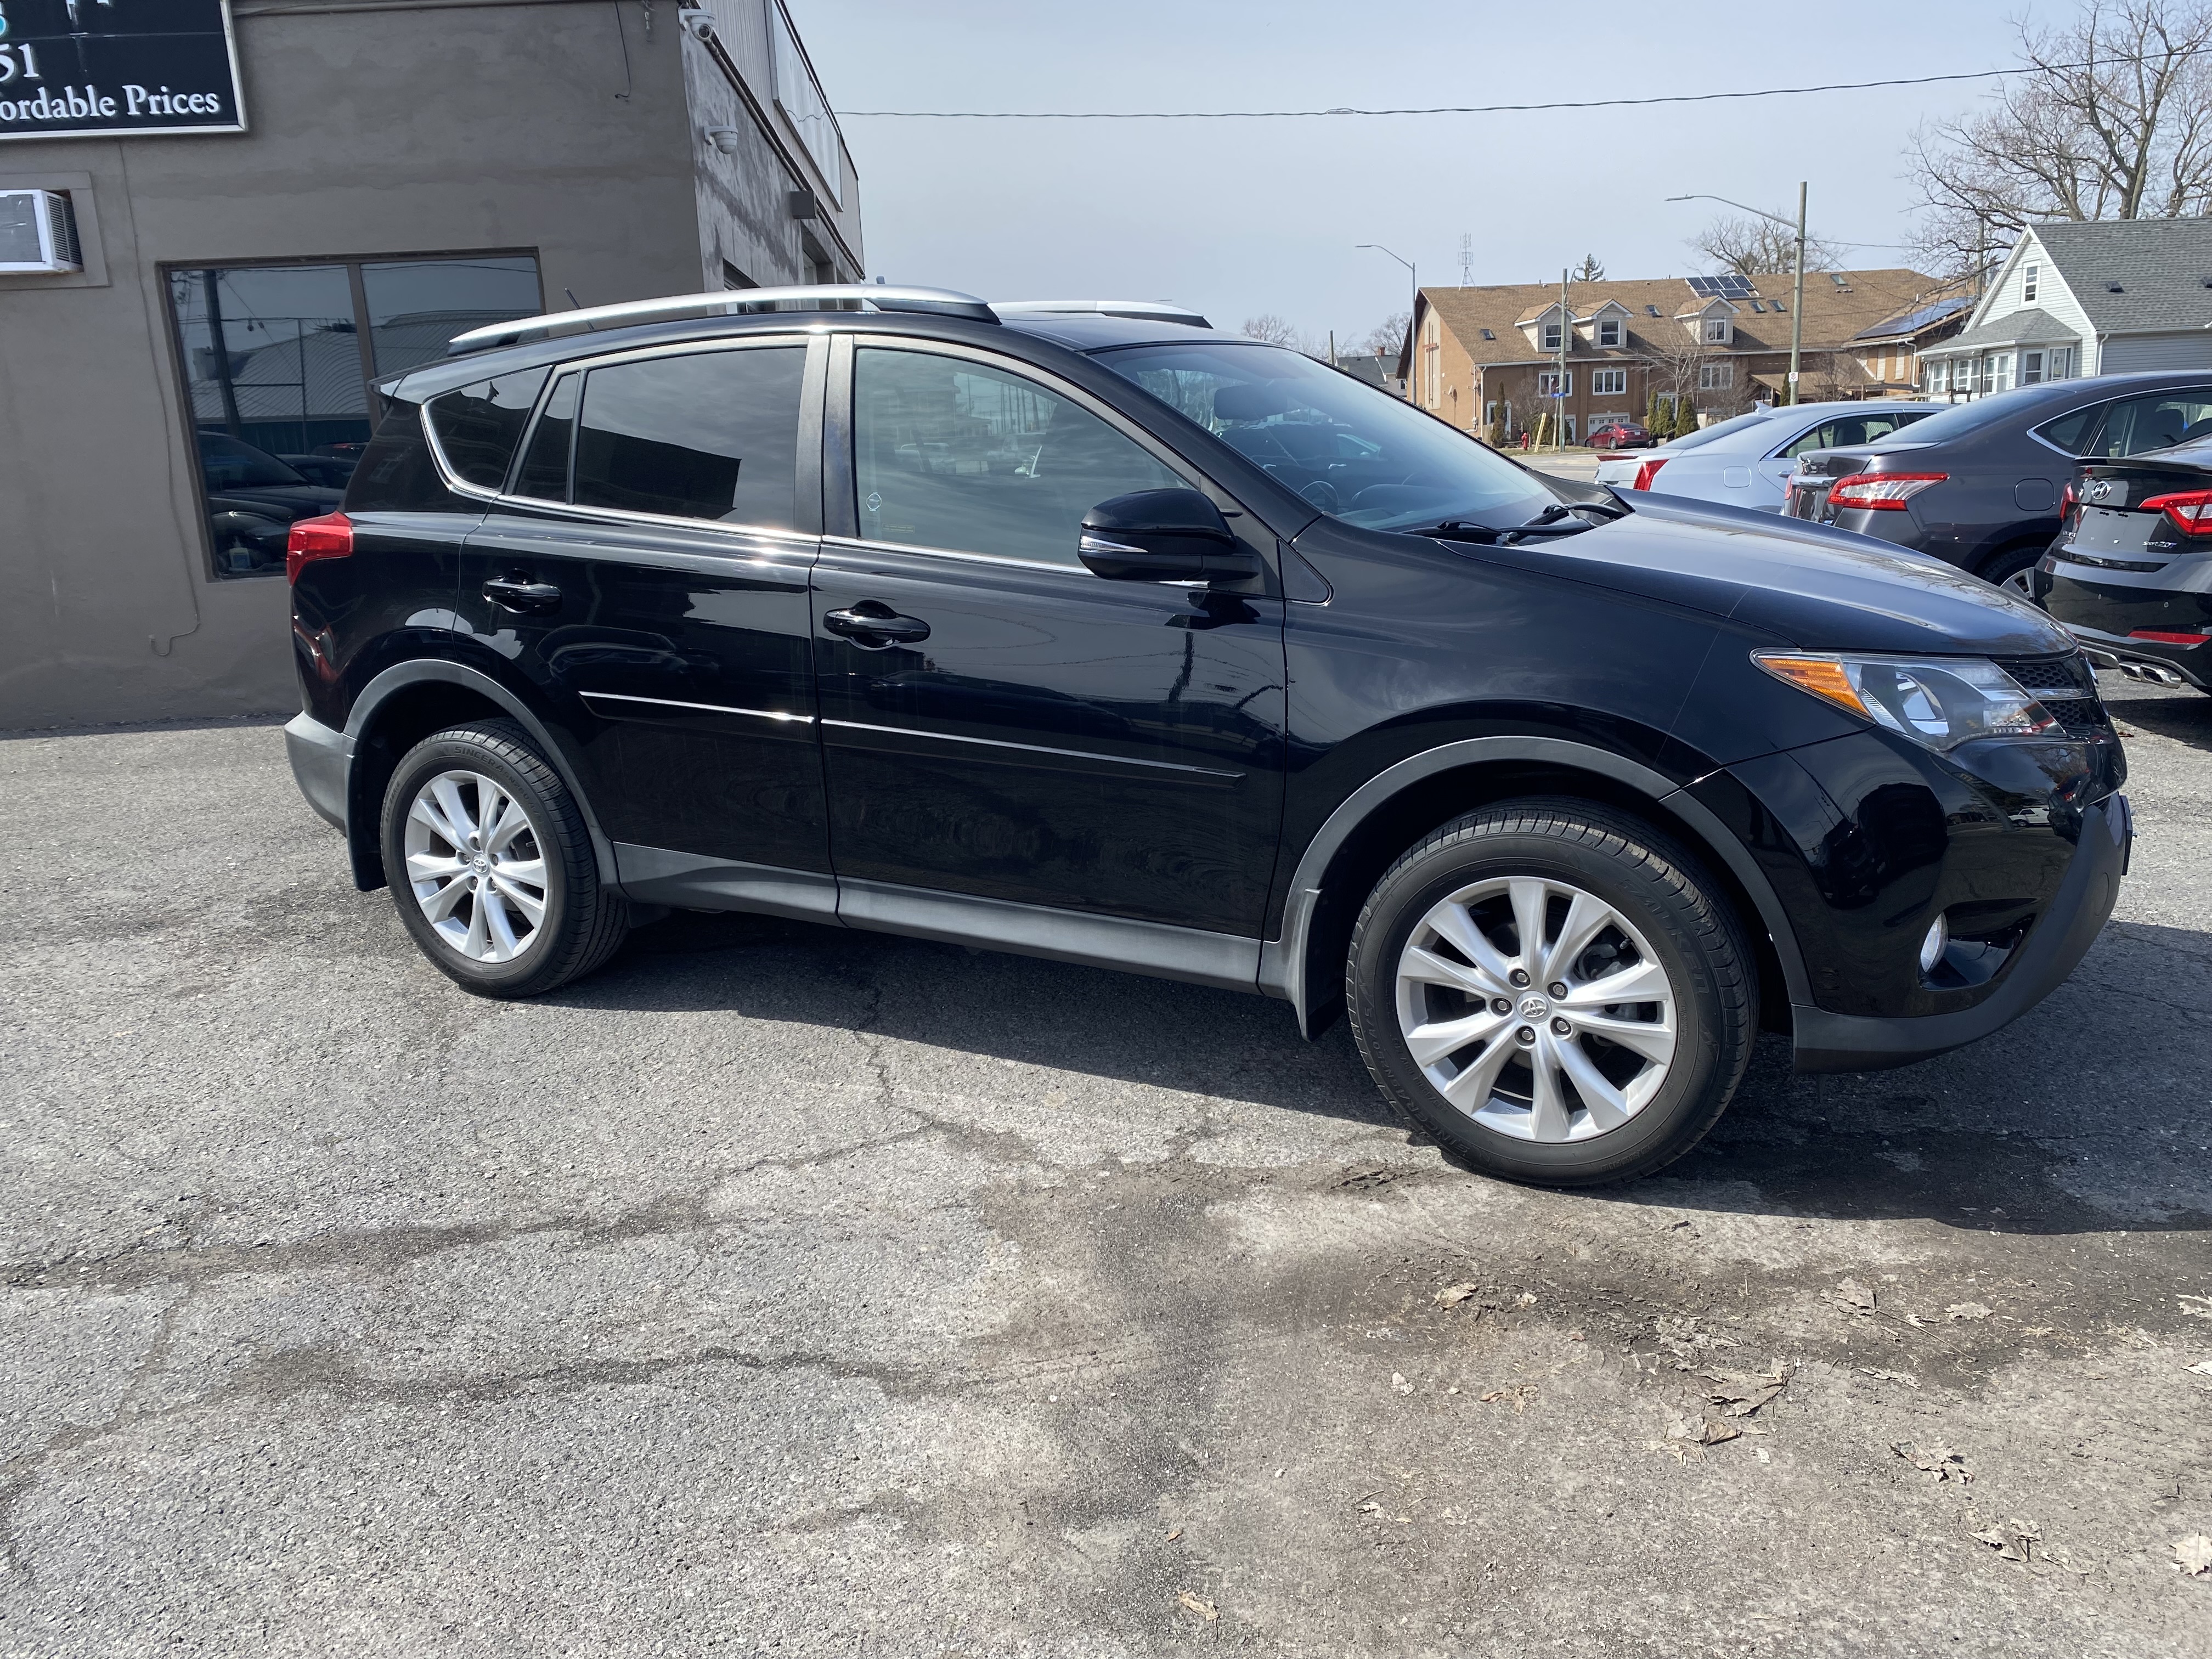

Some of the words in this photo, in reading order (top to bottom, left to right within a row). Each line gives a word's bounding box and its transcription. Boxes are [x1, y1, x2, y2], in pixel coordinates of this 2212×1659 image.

[122, 84, 219, 115] Prices
[454, 746, 503, 772] SINCERA
[1396, 1088, 1471, 1155] SINCERA
